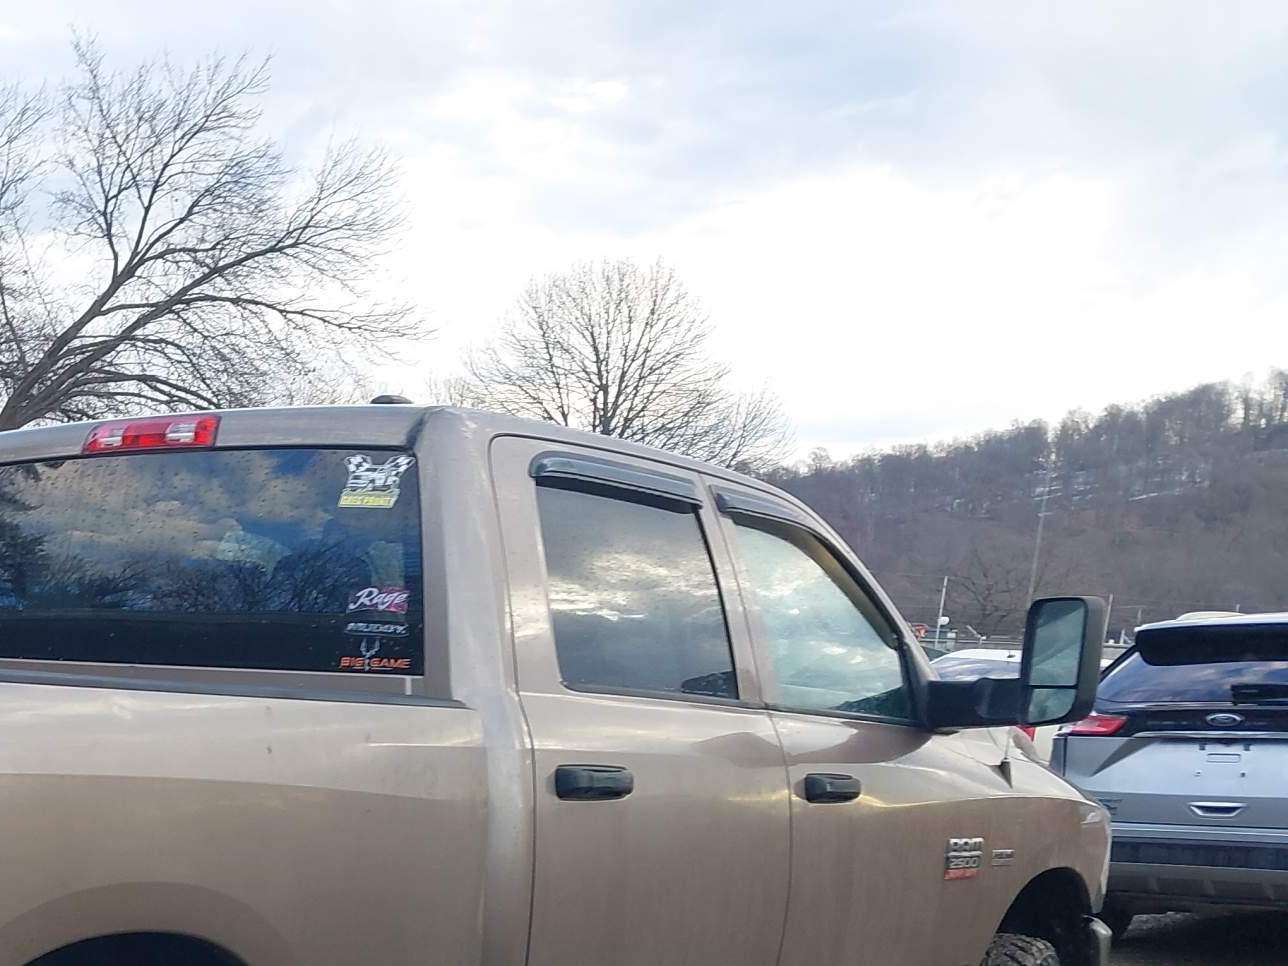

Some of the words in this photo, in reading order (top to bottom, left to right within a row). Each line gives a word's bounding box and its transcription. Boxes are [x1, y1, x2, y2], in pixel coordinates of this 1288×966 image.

[348, 587, 409, 610] Rage
[340, 657, 365, 668] BIG
[370, 658, 411, 669] GAME
[948, 837, 984, 851] RAM
